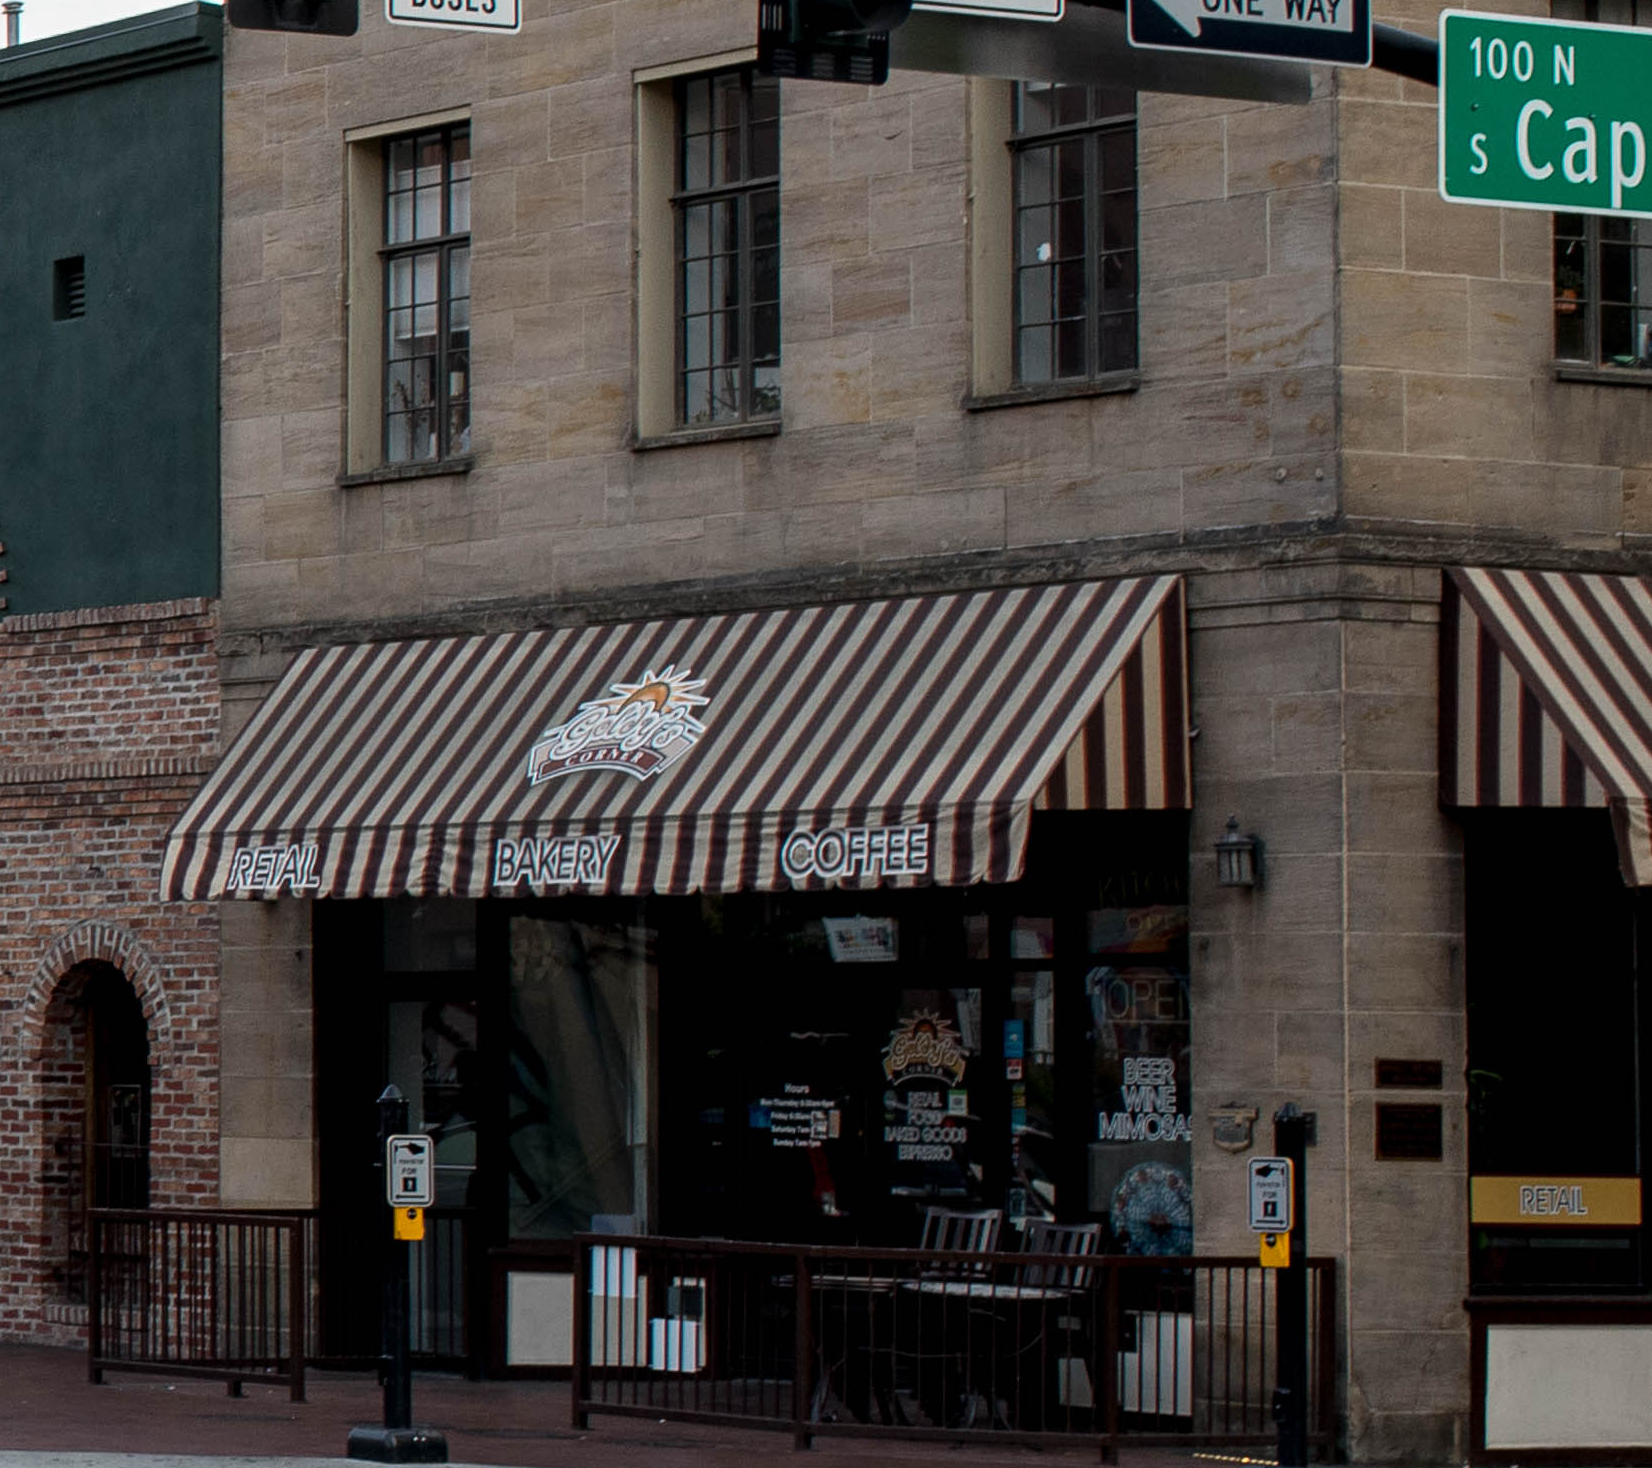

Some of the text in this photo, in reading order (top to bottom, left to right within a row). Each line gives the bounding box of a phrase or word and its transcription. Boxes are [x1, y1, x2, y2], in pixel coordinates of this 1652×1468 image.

[1469, 36, 1575, 86] 100 N
[1469, 98, 1646, 210] S Cap
[549, 698, 691, 761] Goldy's
[564, 745, 644, 767] CORNER
[226, 844, 322, 891] RETAIL
[492, 834, 622, 887] BAKERY
[780, 824, 930, 879] COFFEE
[1123, 1057, 1176, 1086] BEER
[784, 1083, 810, 1094] Hours
[1121, 1085, 1177, 1113] WINE
[921, 1126, 968, 1144] GOODS
[898, 1144, 953, 1161] ESPRESSO
[1520, 1184, 1588, 1216] RETAIL
